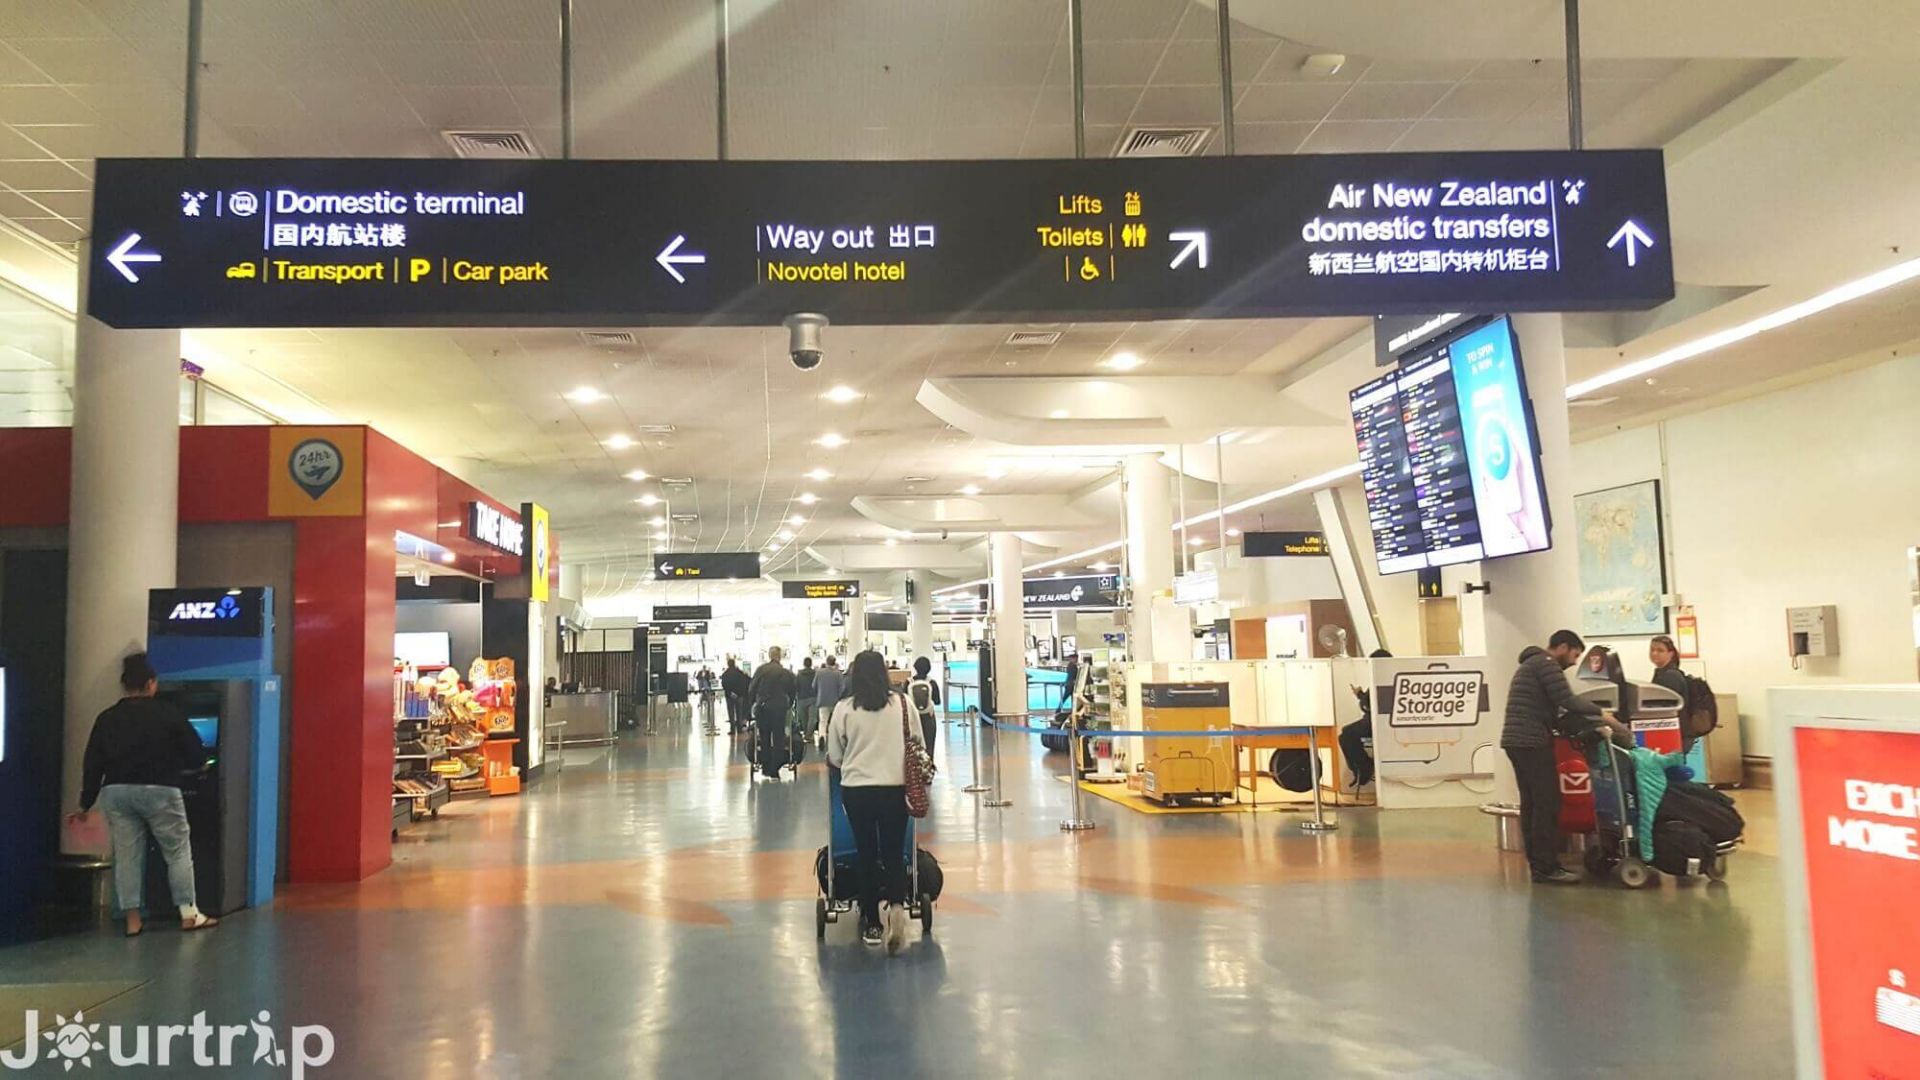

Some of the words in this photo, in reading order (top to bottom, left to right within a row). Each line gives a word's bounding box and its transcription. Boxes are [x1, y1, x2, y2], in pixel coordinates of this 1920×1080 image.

[276, 190, 408, 214] Domestic
[415, 191, 524, 214] terminal
[1328, 184, 1365, 208] Air
[1373, 184, 1432, 208] New
[1440, 180, 1547, 206] Zealand
[1059, 195, 1102, 215] Lifts
[273, 223, 406, 247] 国内航站楼
[1037, 227, 1104, 247] Toilets
[1302, 216, 1426, 242] domestic
[1432, 214, 1549, 239] transfers
[766, 225, 823, 253] Way
[832, 228, 875, 249] out
[888, 225, 936, 249] 出口
[273, 260, 384, 284] Transport
[410, 260, 430, 281] P
[453, 261, 494, 281] Car
[499, 259, 549, 284] park
[768, 261, 848, 281] Novotel
[854, 261, 905, 281] hotel
[1308, 248, 1548, 275] 新西兰航空国内转机柜台
[1037, 593, 1071, 602] ZEALAND
[168, 601, 217, 619] ANZ
[831, 608, 843, 624] A
[1399, 678, 1477, 699] Baggage
[1396, 697, 1465, 717] Storage
